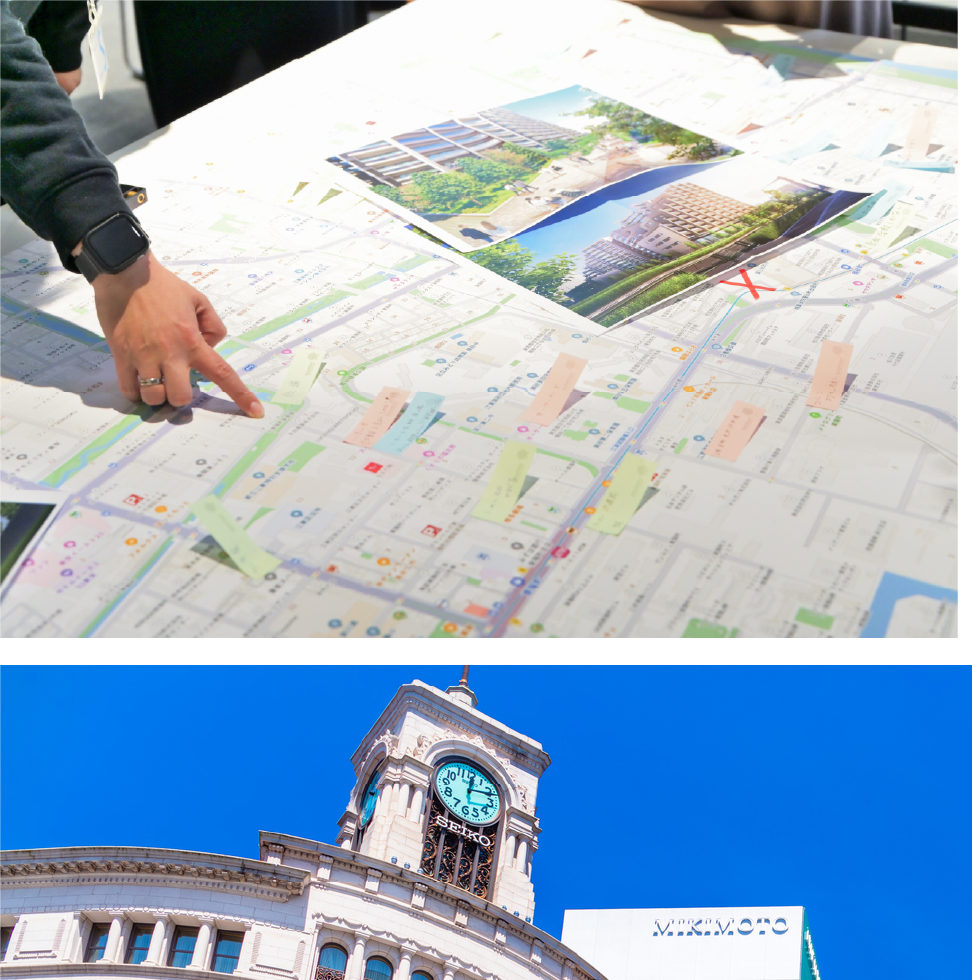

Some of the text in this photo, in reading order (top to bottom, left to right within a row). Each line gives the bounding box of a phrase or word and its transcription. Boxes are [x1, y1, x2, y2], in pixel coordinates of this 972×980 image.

[447, 770, 457, 781] 10
[457, 767, 465, 778] 11
[444, 786, 453, 798] 8
[453, 797, 461, 808] 7
[461, 805, 470, 816] 6
[471, 807, 480, 818] 5
[480, 806, 490, 816] 4
[436, 815, 491, 847] SEIKO
[652, 917, 790, 937] MIKIMOTO
